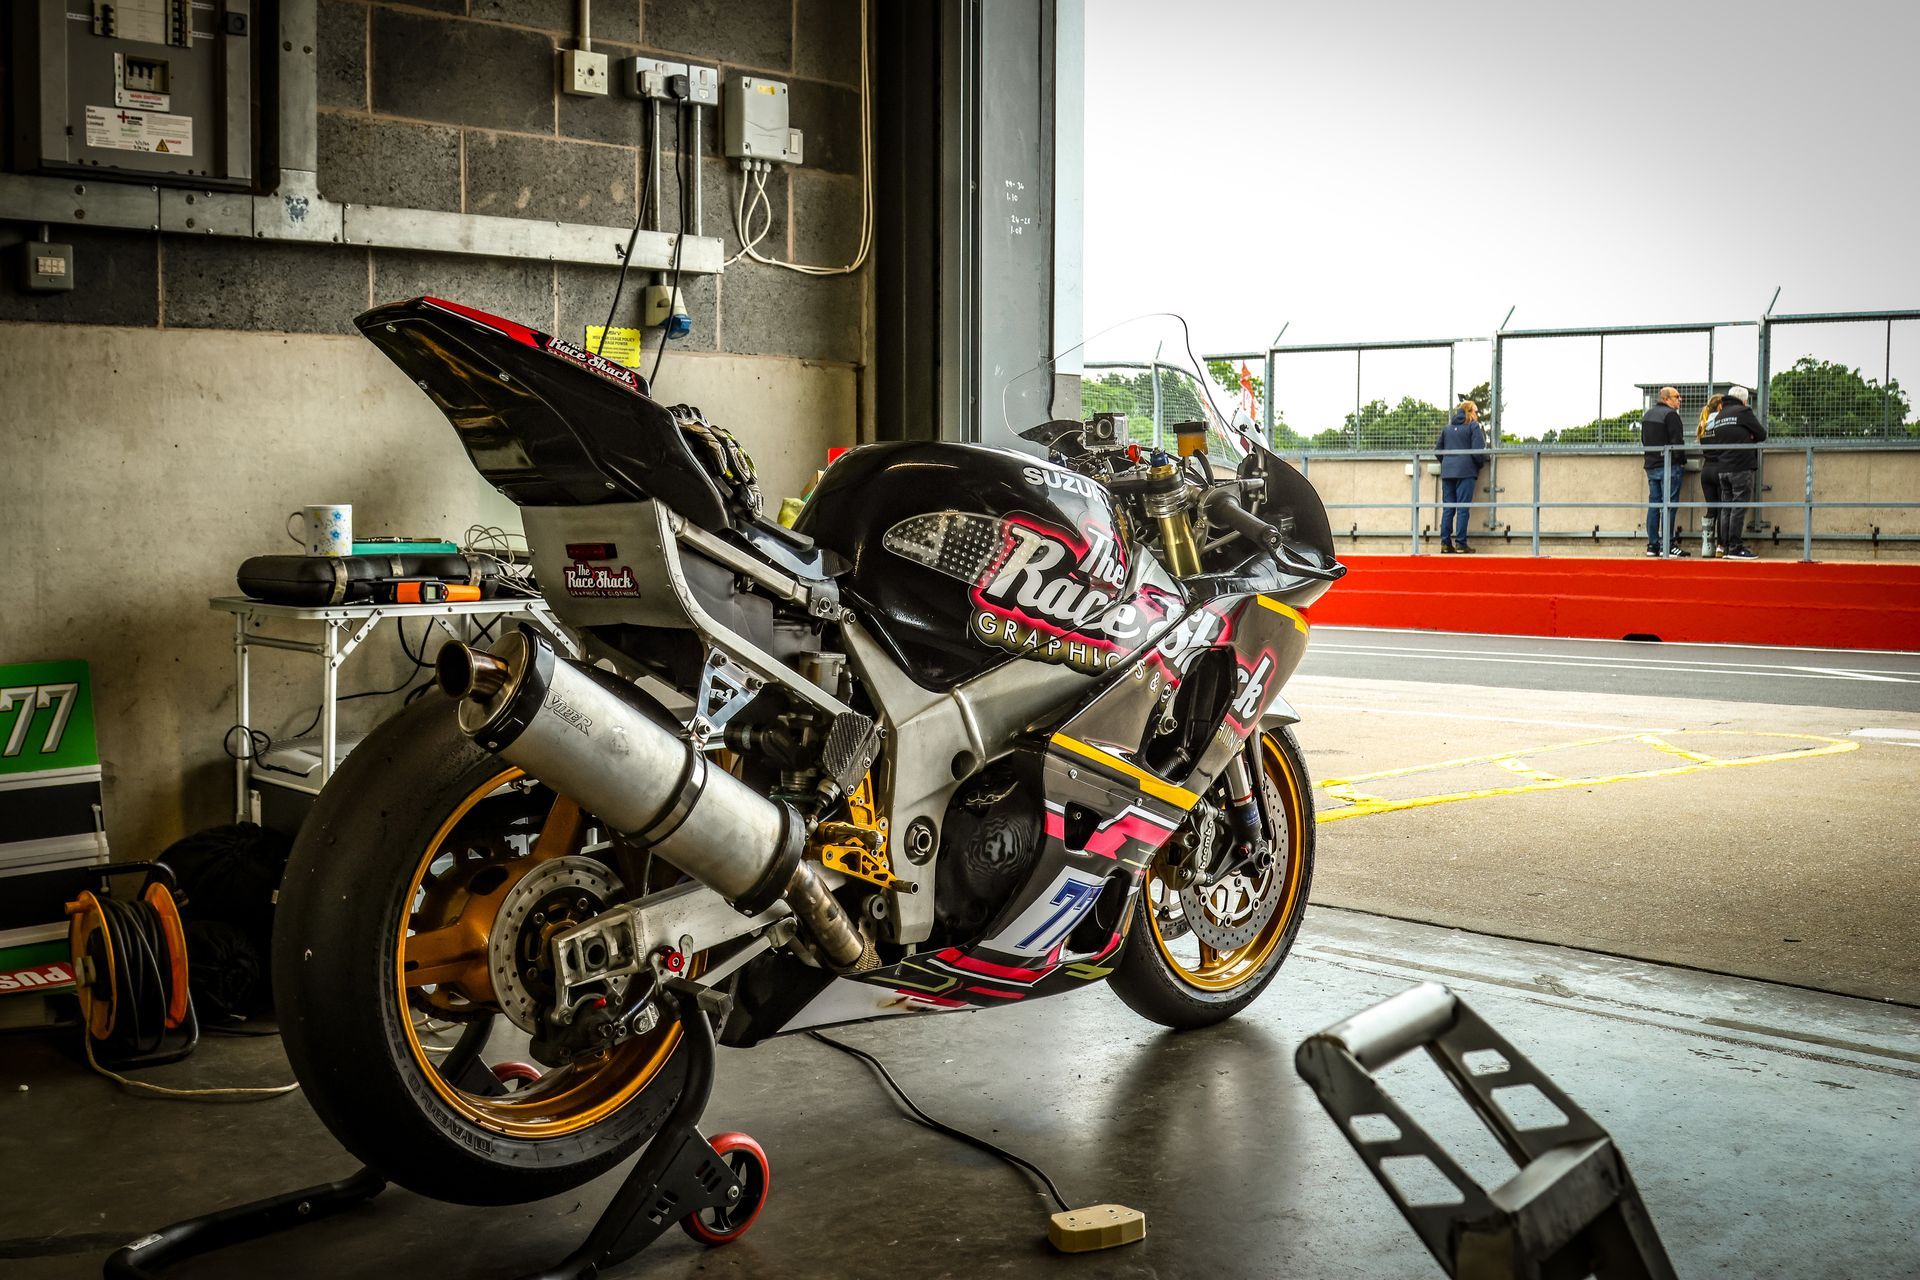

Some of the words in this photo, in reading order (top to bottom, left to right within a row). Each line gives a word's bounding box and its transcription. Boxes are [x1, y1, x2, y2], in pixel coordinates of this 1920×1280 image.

[549, 337, 587, 362] Race
[587, 354, 633, 384] Shack
[566, 570, 596, 588] Race
[595, 570, 633, 588] Shack
[576, 564, 591, 576] The
[1078, 527, 1124, 589] The
[986, 527, 1141, 639] Race
[1149, 671, 1161, 693] &
[543, 687, 593, 737] VIPER
[1199, 819, 1215, 870] brembo
